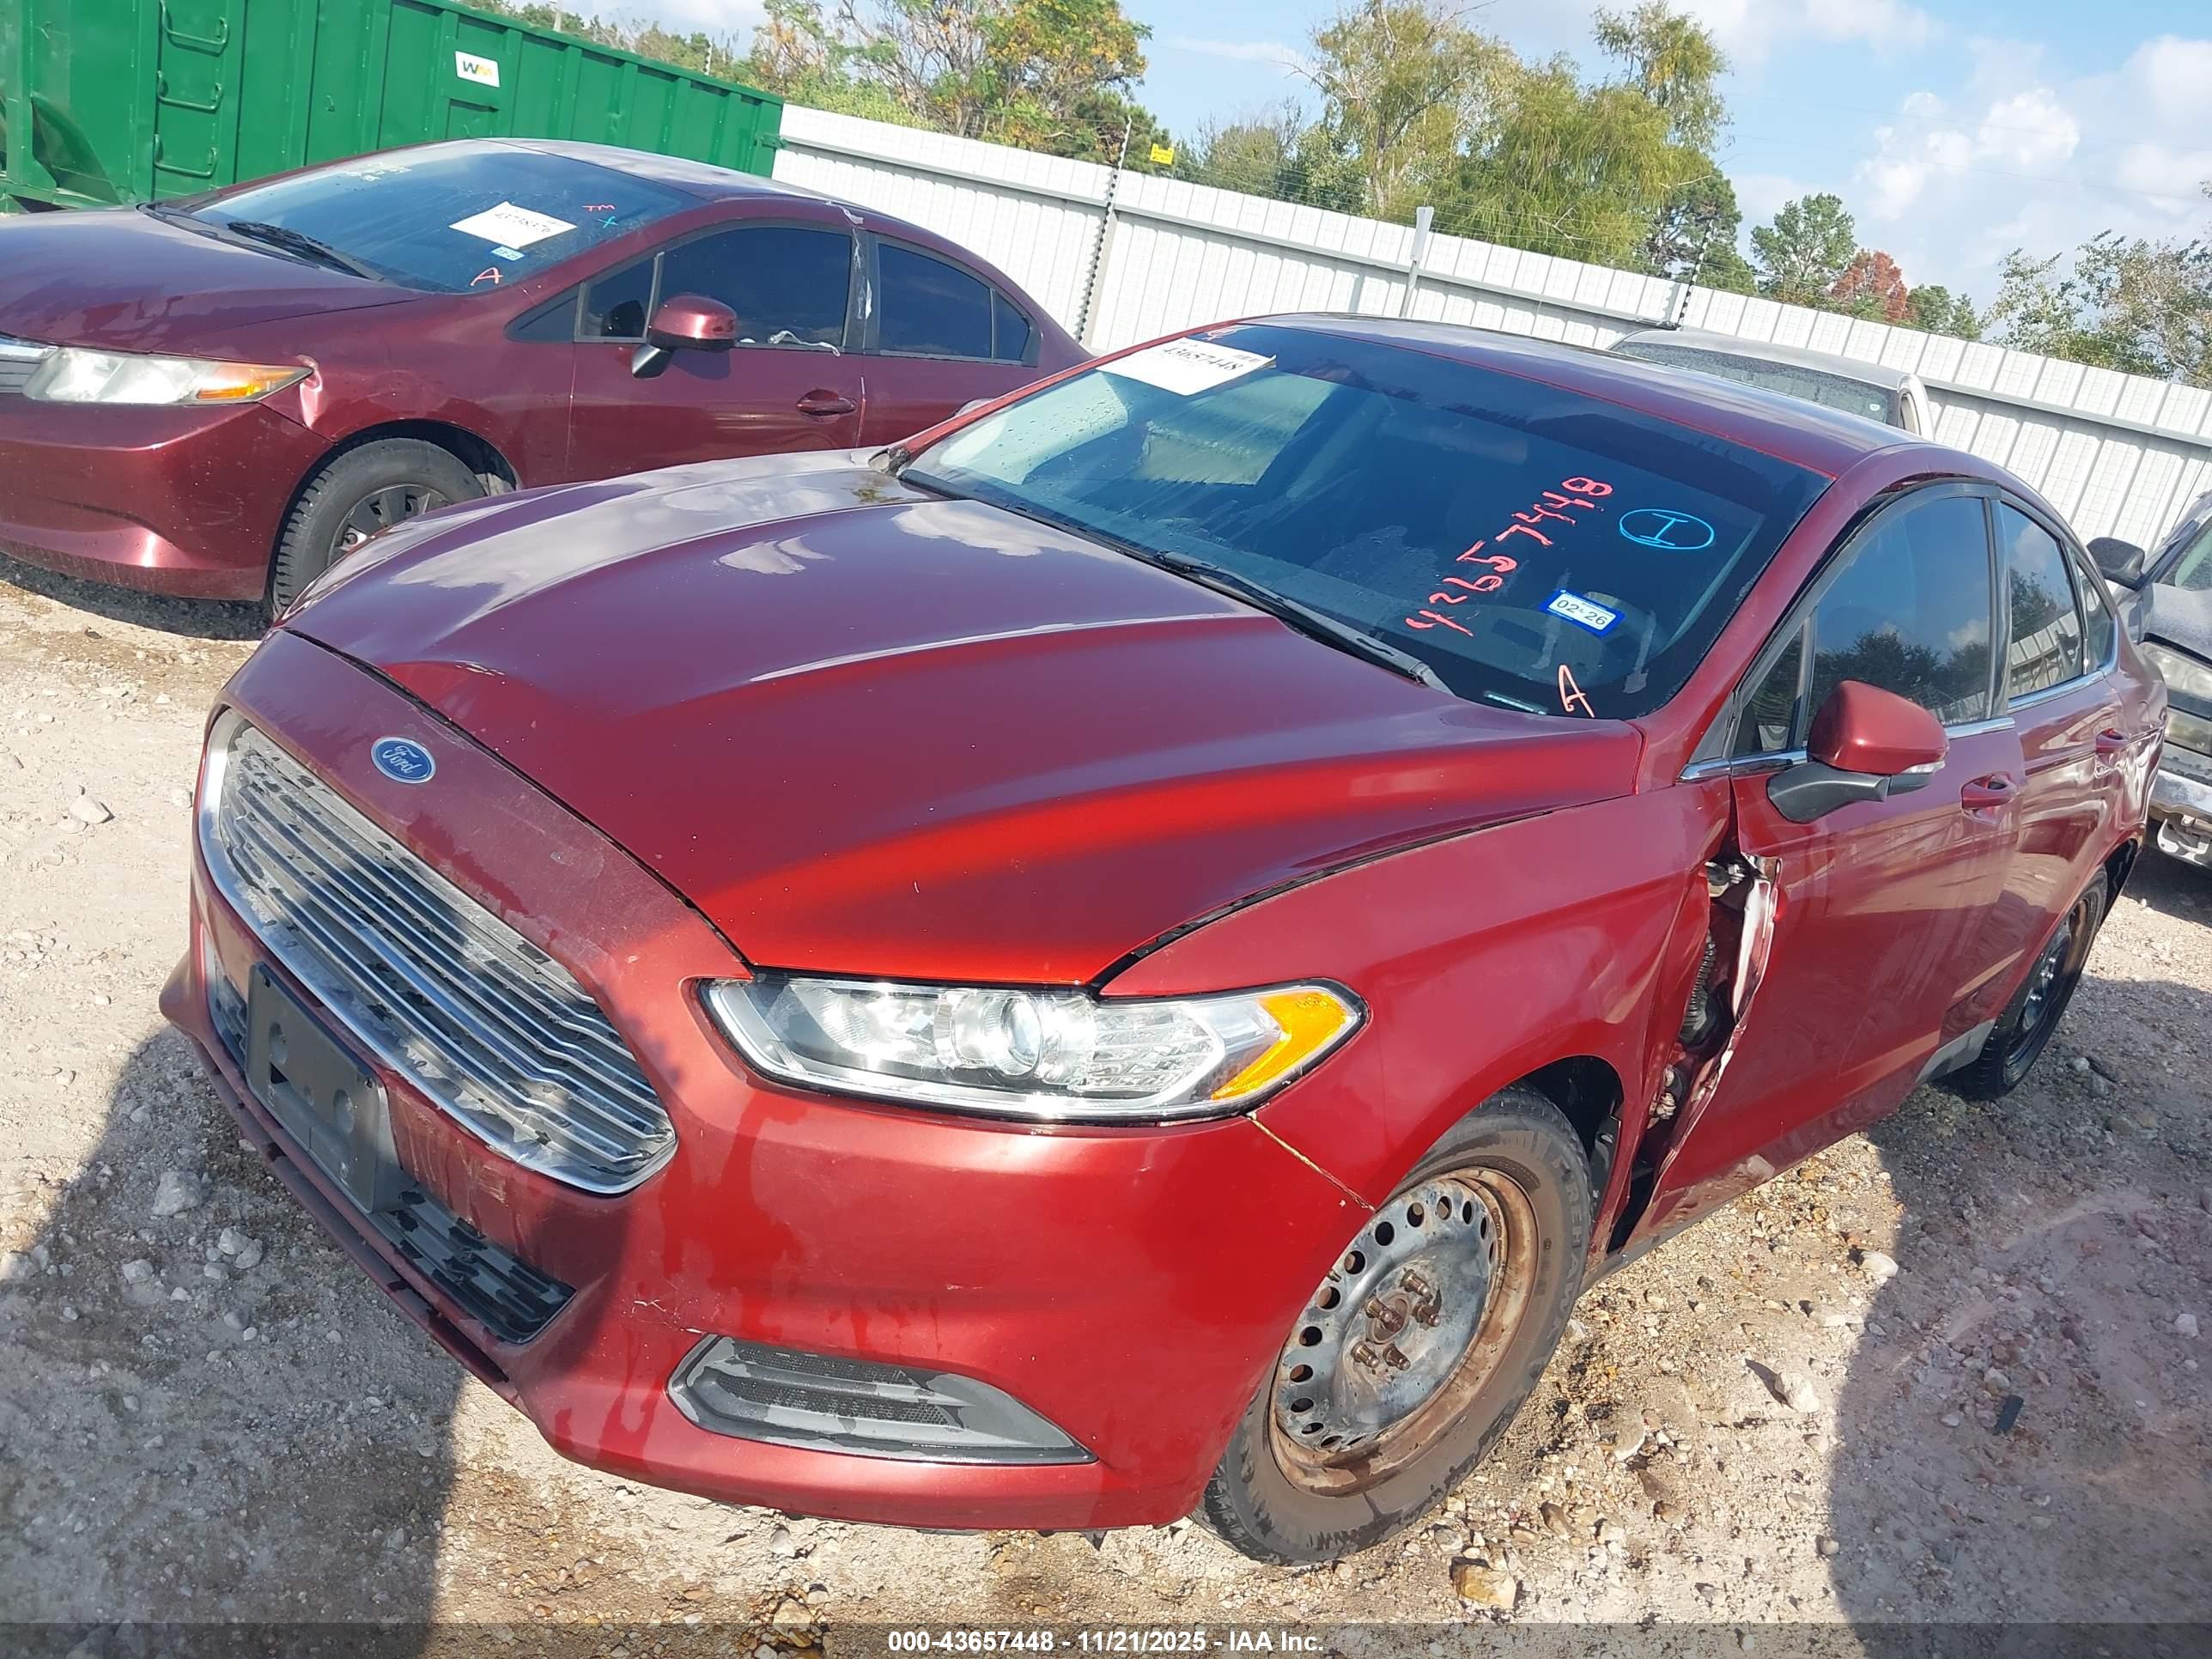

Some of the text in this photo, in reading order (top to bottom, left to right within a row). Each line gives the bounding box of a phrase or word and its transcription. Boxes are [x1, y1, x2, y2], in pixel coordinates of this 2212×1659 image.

[462, 60, 493, 78] WM
[470, 266, 504, 287] A
[382, 744, 423, 774] Ford
